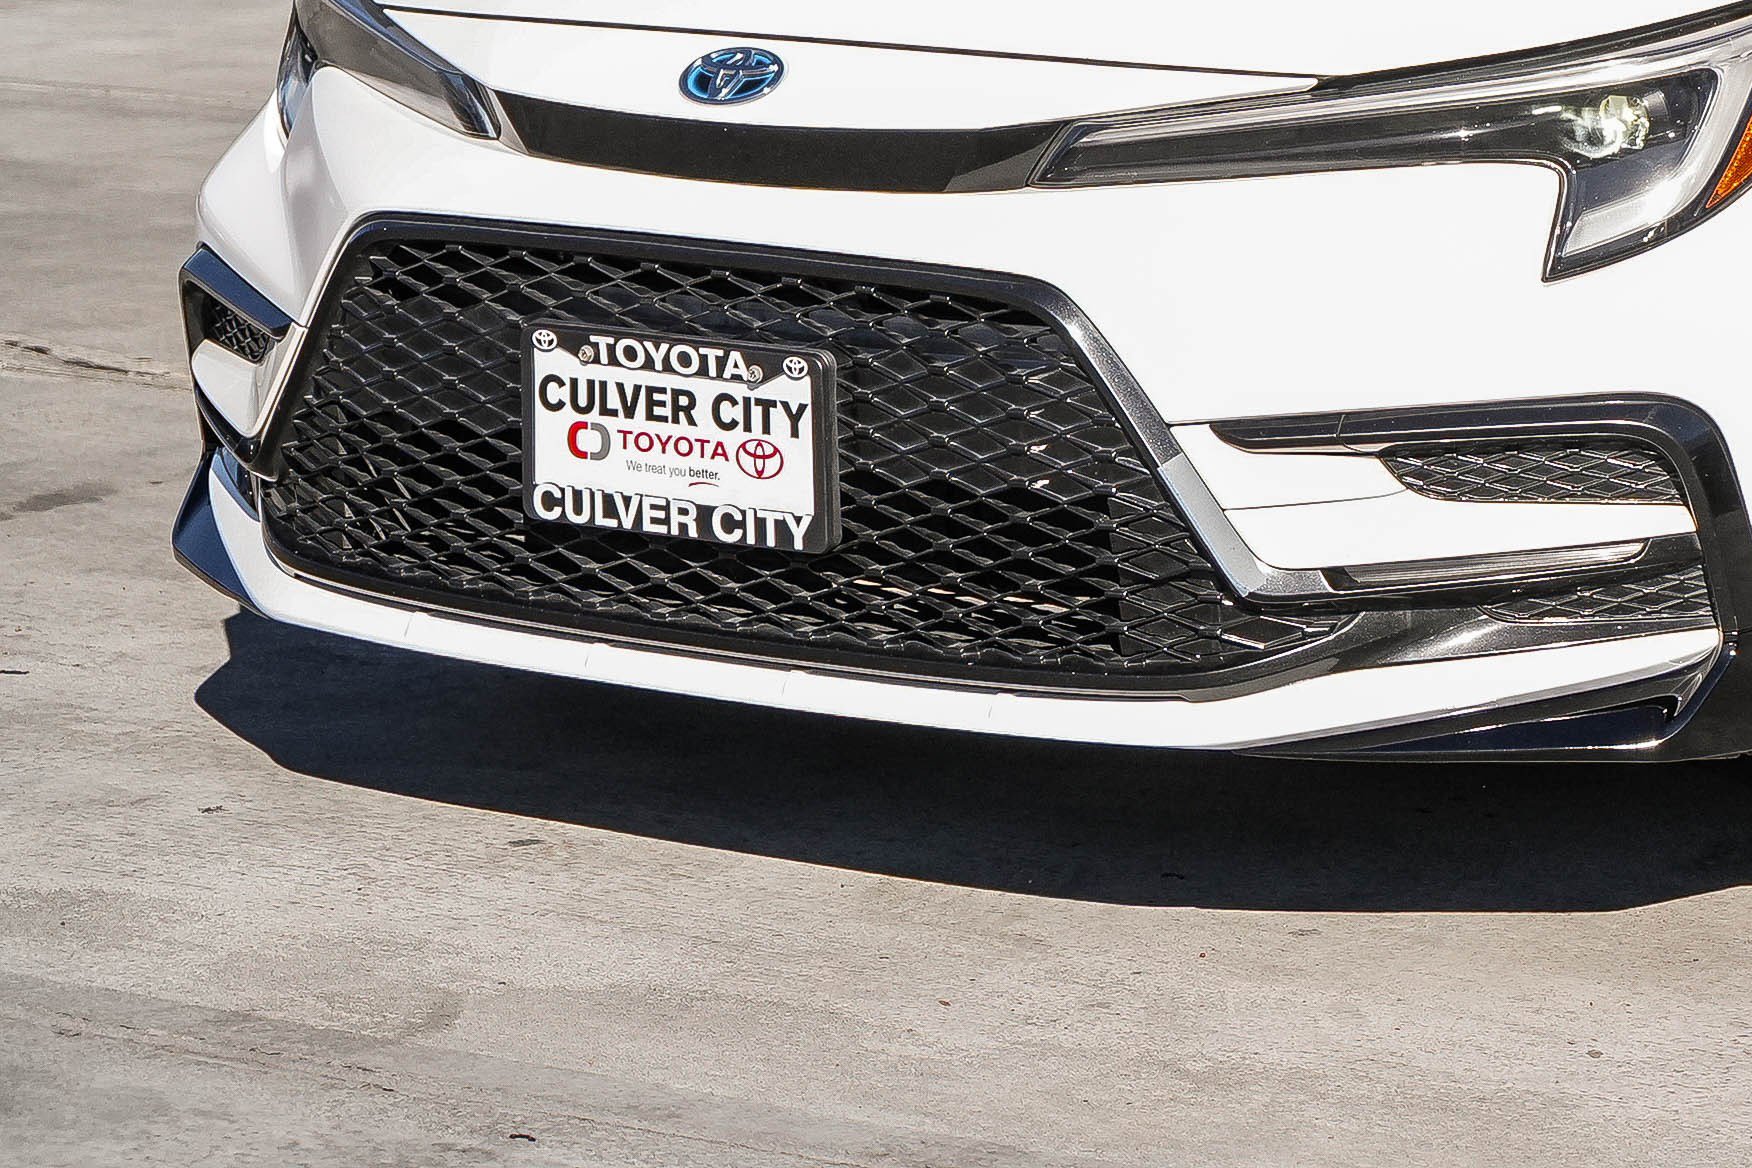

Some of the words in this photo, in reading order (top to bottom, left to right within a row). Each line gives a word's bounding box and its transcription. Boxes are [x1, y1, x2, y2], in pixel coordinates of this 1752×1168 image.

[589, 334, 750, 381] TOYOTA
[538, 373, 698, 427] CULVER
[711, 392, 809, 440] CITY
[616, 429, 730, 462] TOYOTA
[625, 460, 643, 473] We
[645, 462, 667, 475] treat
[669, 467, 687, 478] you
[688, 466, 721, 481] better.
[533, 482, 698, 538] CULVER
[711, 504, 813, 551] CITY
